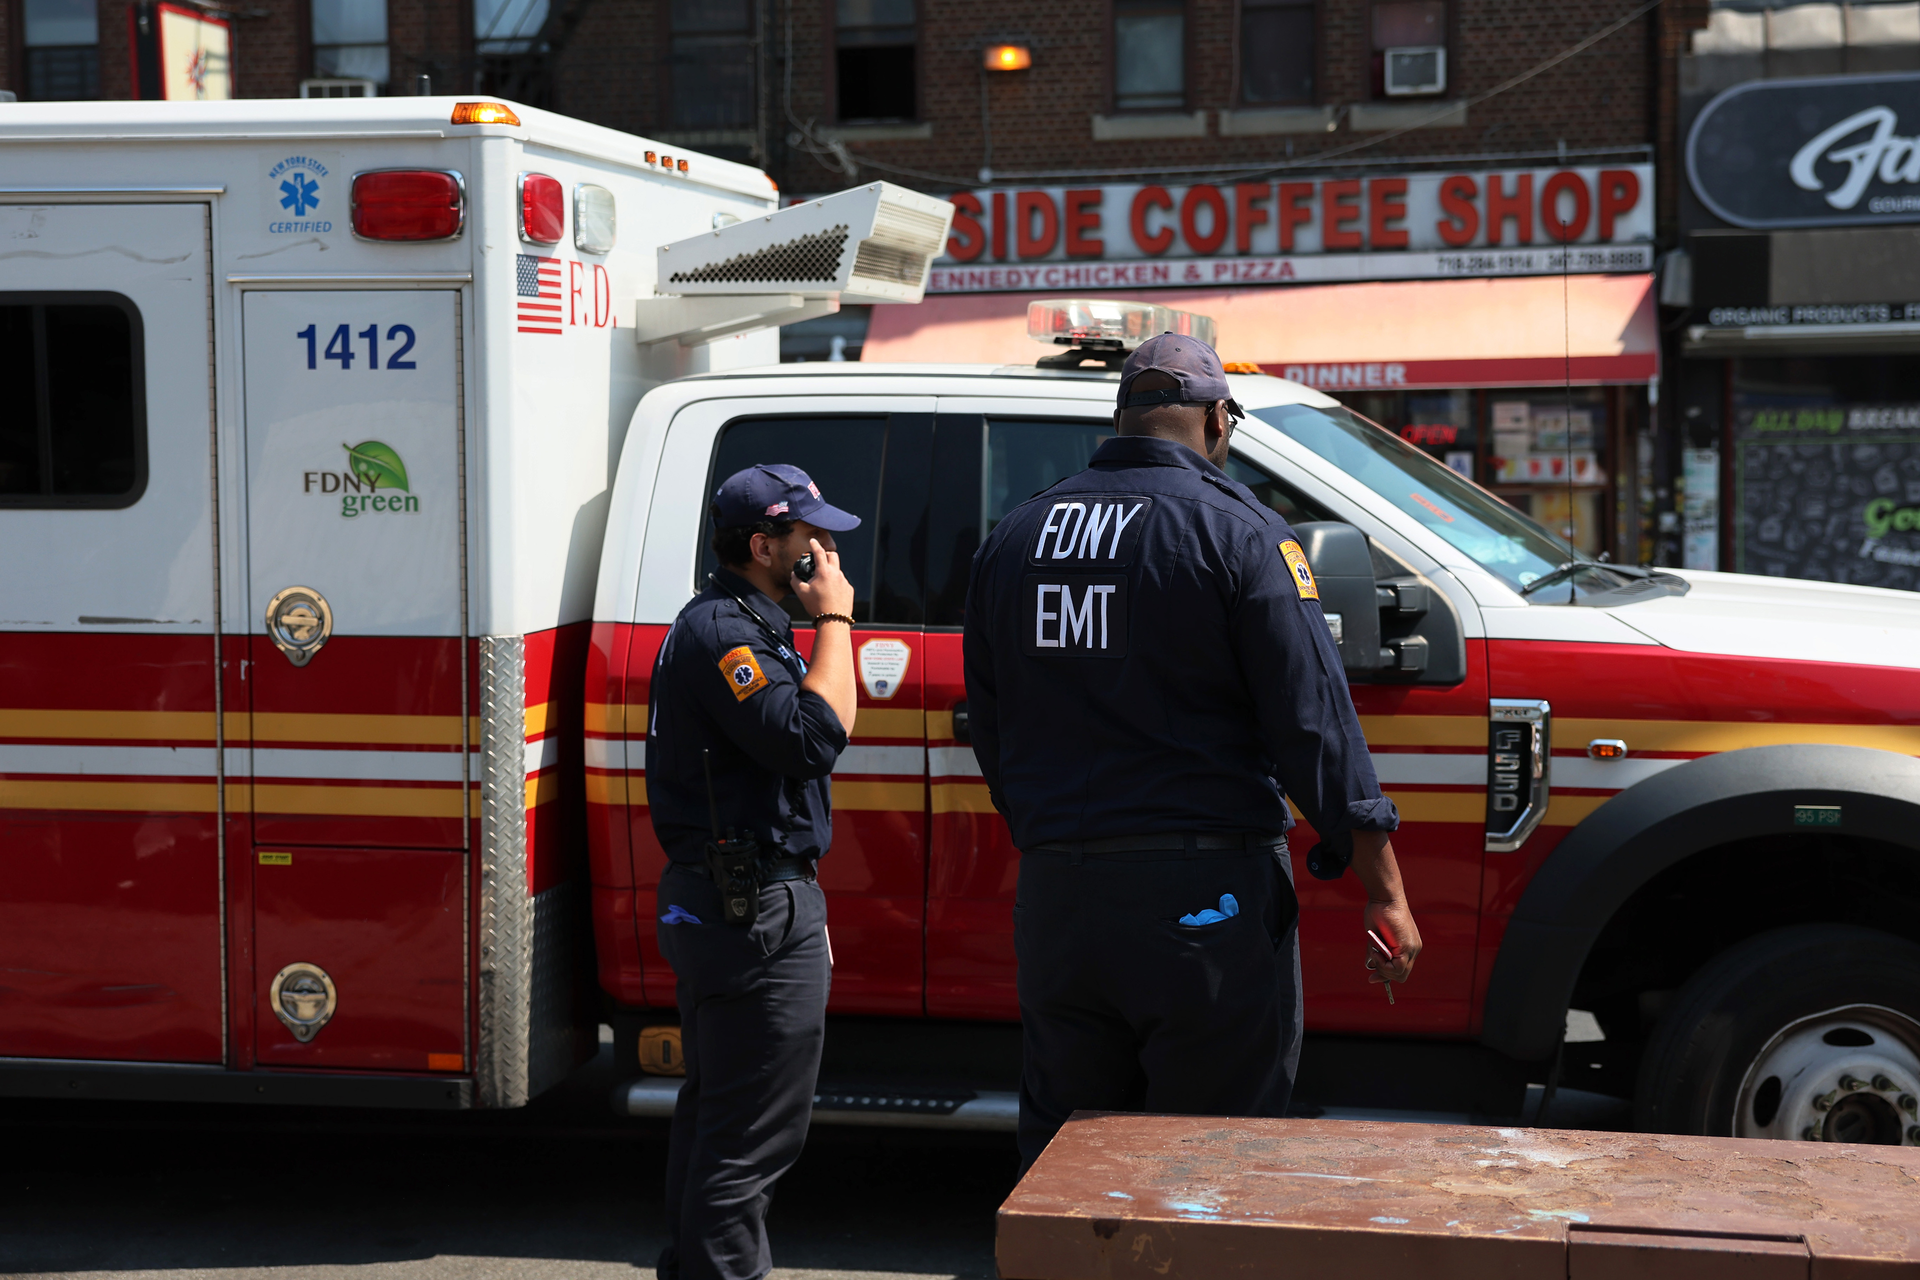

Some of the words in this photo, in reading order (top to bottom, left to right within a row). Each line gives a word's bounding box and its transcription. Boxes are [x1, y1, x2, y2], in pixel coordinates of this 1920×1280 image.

[269, 161, 286, 179] NEW
[284, 156, 307, 166] YORK
[308, 158, 330, 178] STATE
[1789, 105, 1920, 210] Fa
[947, 188, 1105, 262] SIDE
[1129, 178, 1410, 256] COFFEE
[1437, 169, 1640, 248] SHOP
[269, 221, 332, 234] CERTIFIED
[1183, 264, 1202, 282] &
[1213, 260, 1297, 281] PIZZA
[569, 260, 617, 329] F.D.
[1709, 307, 1790, 325] ORGANIC
[1793, 303, 1891, 323] PRODUCTS
[297, 324, 417, 369] 1412
[1284, 362, 1406, 386] DINNER
[1752, 410, 1793, 432] ALL
[1400, 424, 1458, 445] OPEN
[304, 472, 382, 493] FDNY
[342, 495, 419, 517] green
[1035, 502, 1143, 559] FDNY
[1036, 584, 1116, 649] EMT
[723, 649, 742, 664] FDNY
[1493, 730, 1521, 812] F550
[1799, 811, 1815, 823] 95
[1818, 811, 1838, 823] PSI
